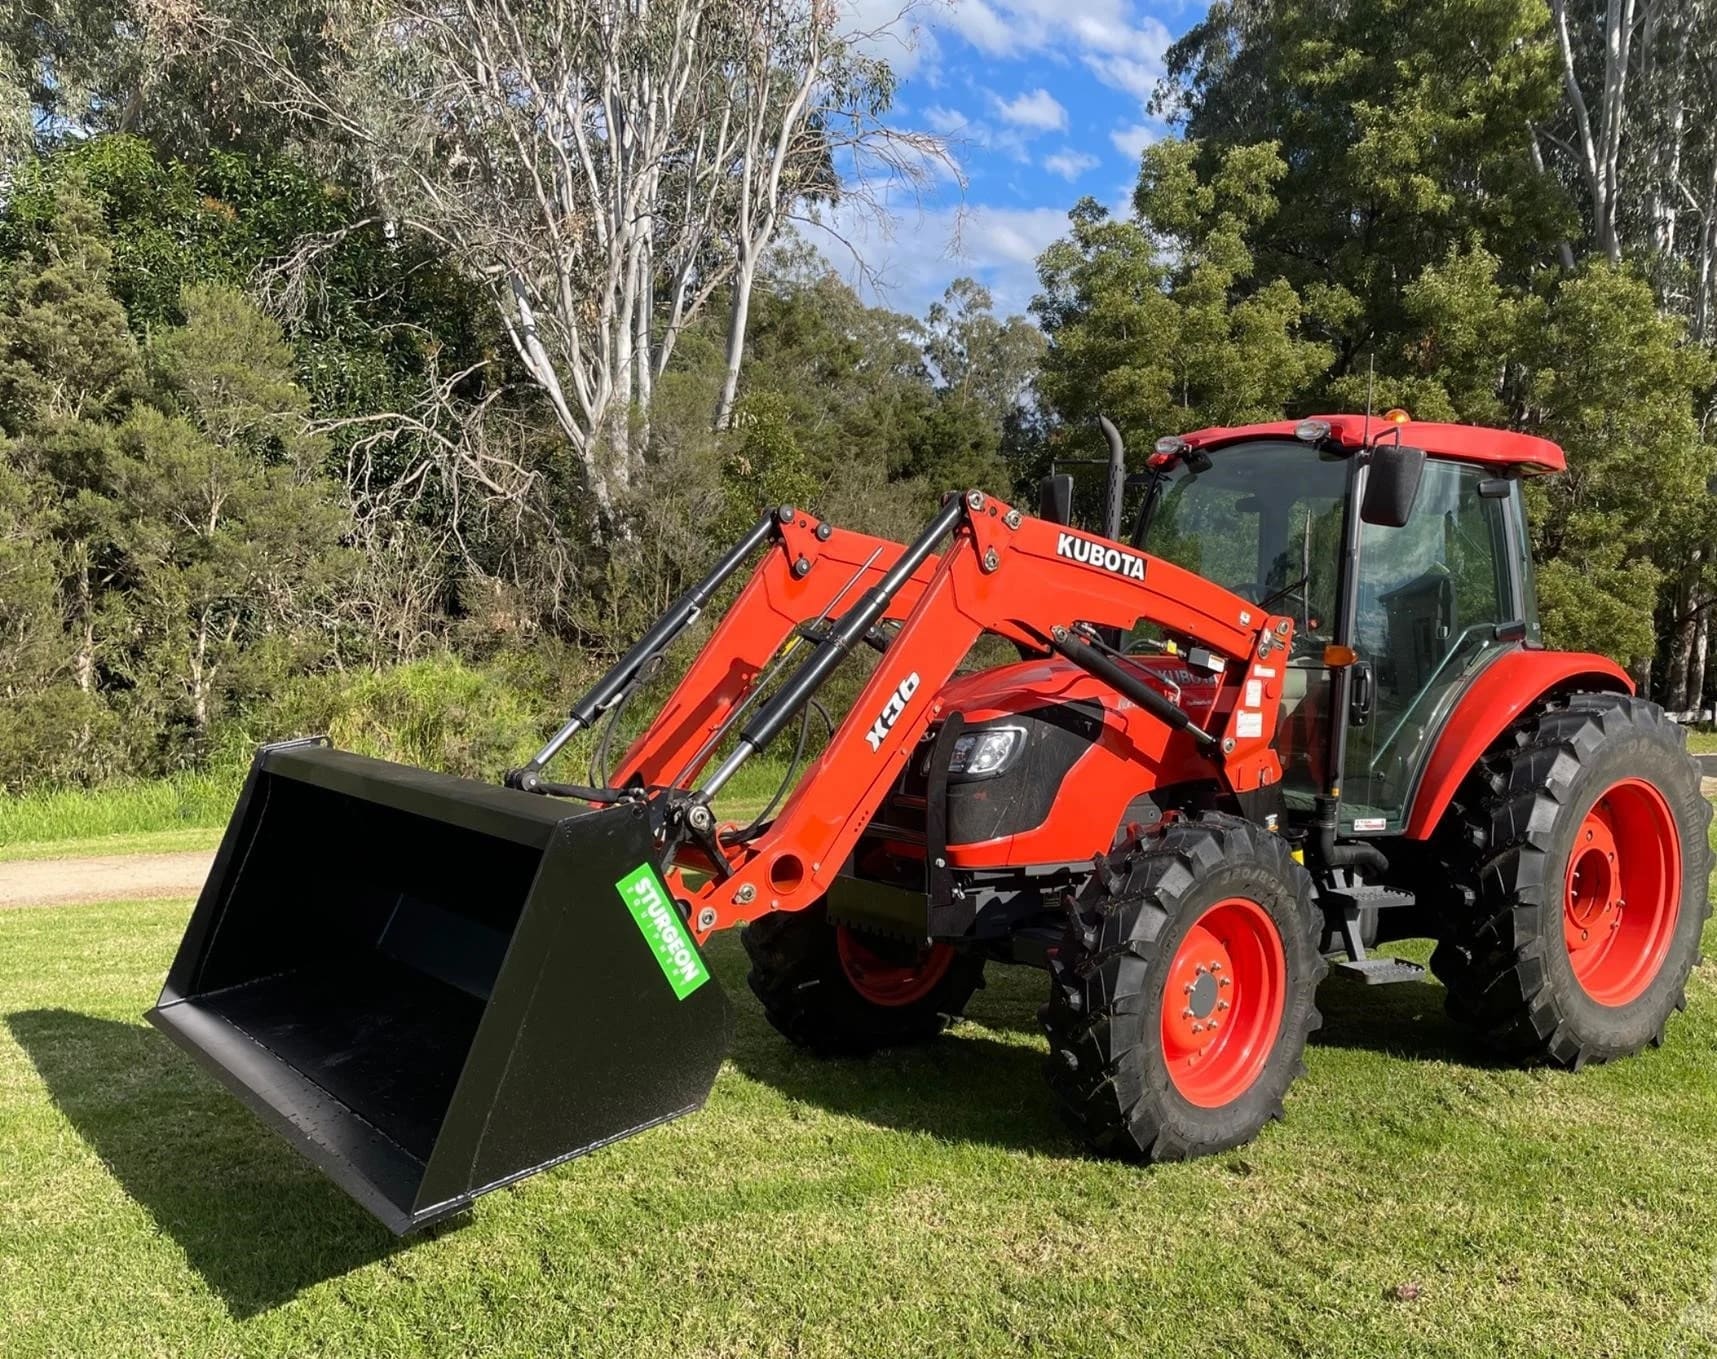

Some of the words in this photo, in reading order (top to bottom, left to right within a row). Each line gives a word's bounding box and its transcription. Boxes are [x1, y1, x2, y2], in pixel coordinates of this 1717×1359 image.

[1057, 532, 1145, 580] KUBOTA
[865, 672, 920, 753] X36
[626, 886, 687, 987] EQUIPMENT
[634, 876, 700, 982] STURGEON
